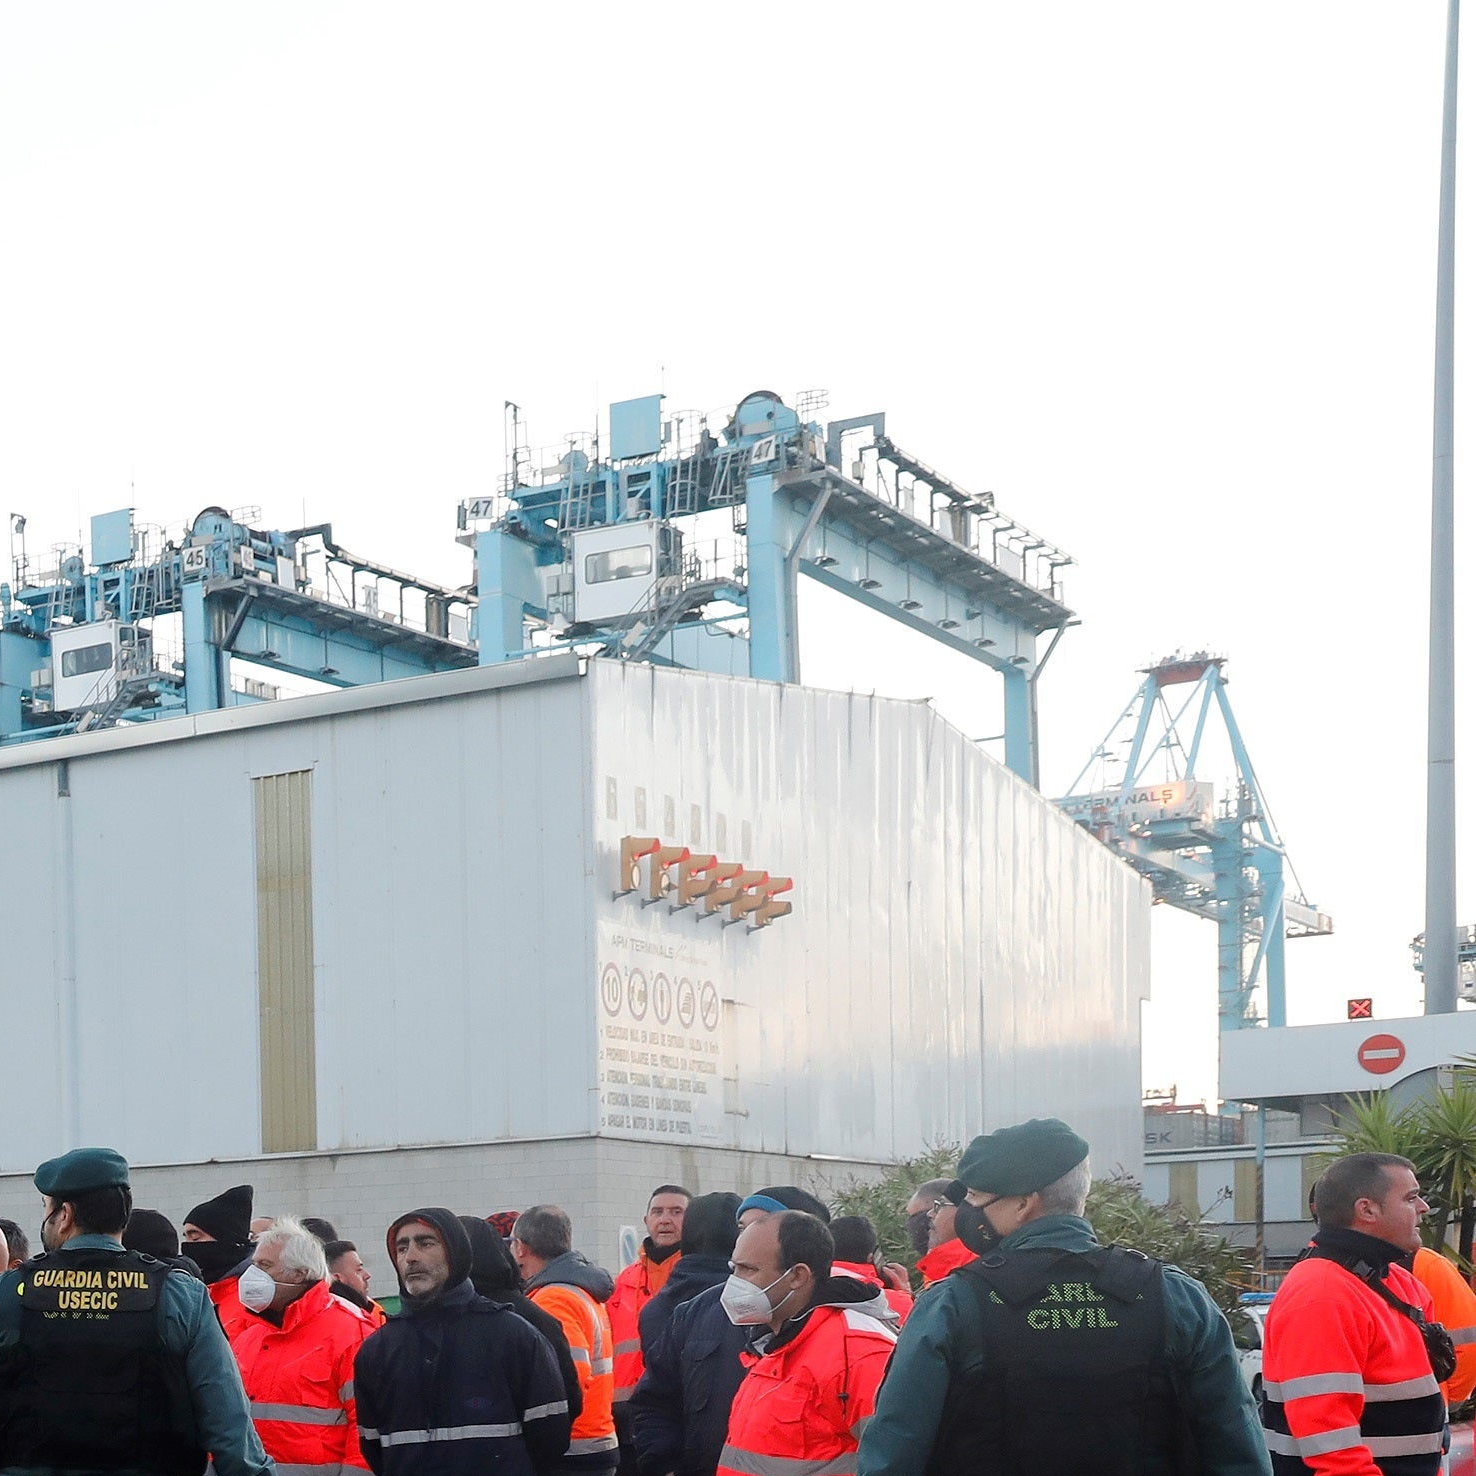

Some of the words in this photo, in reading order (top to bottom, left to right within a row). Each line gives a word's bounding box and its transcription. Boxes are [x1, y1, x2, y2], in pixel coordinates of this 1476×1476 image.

[753, 438, 774, 461] 47
[469, 499, 492, 518] 47
[185, 549, 205, 568] 45
[606, 976, 619, 1003] 10
[33, 1269, 103, 1288] GUARDIA
[107, 1271, 149, 1289] CIVIL
[58, 1291, 119, 1310] USECIC
[1027, 1307, 1119, 1330] CIVIL
